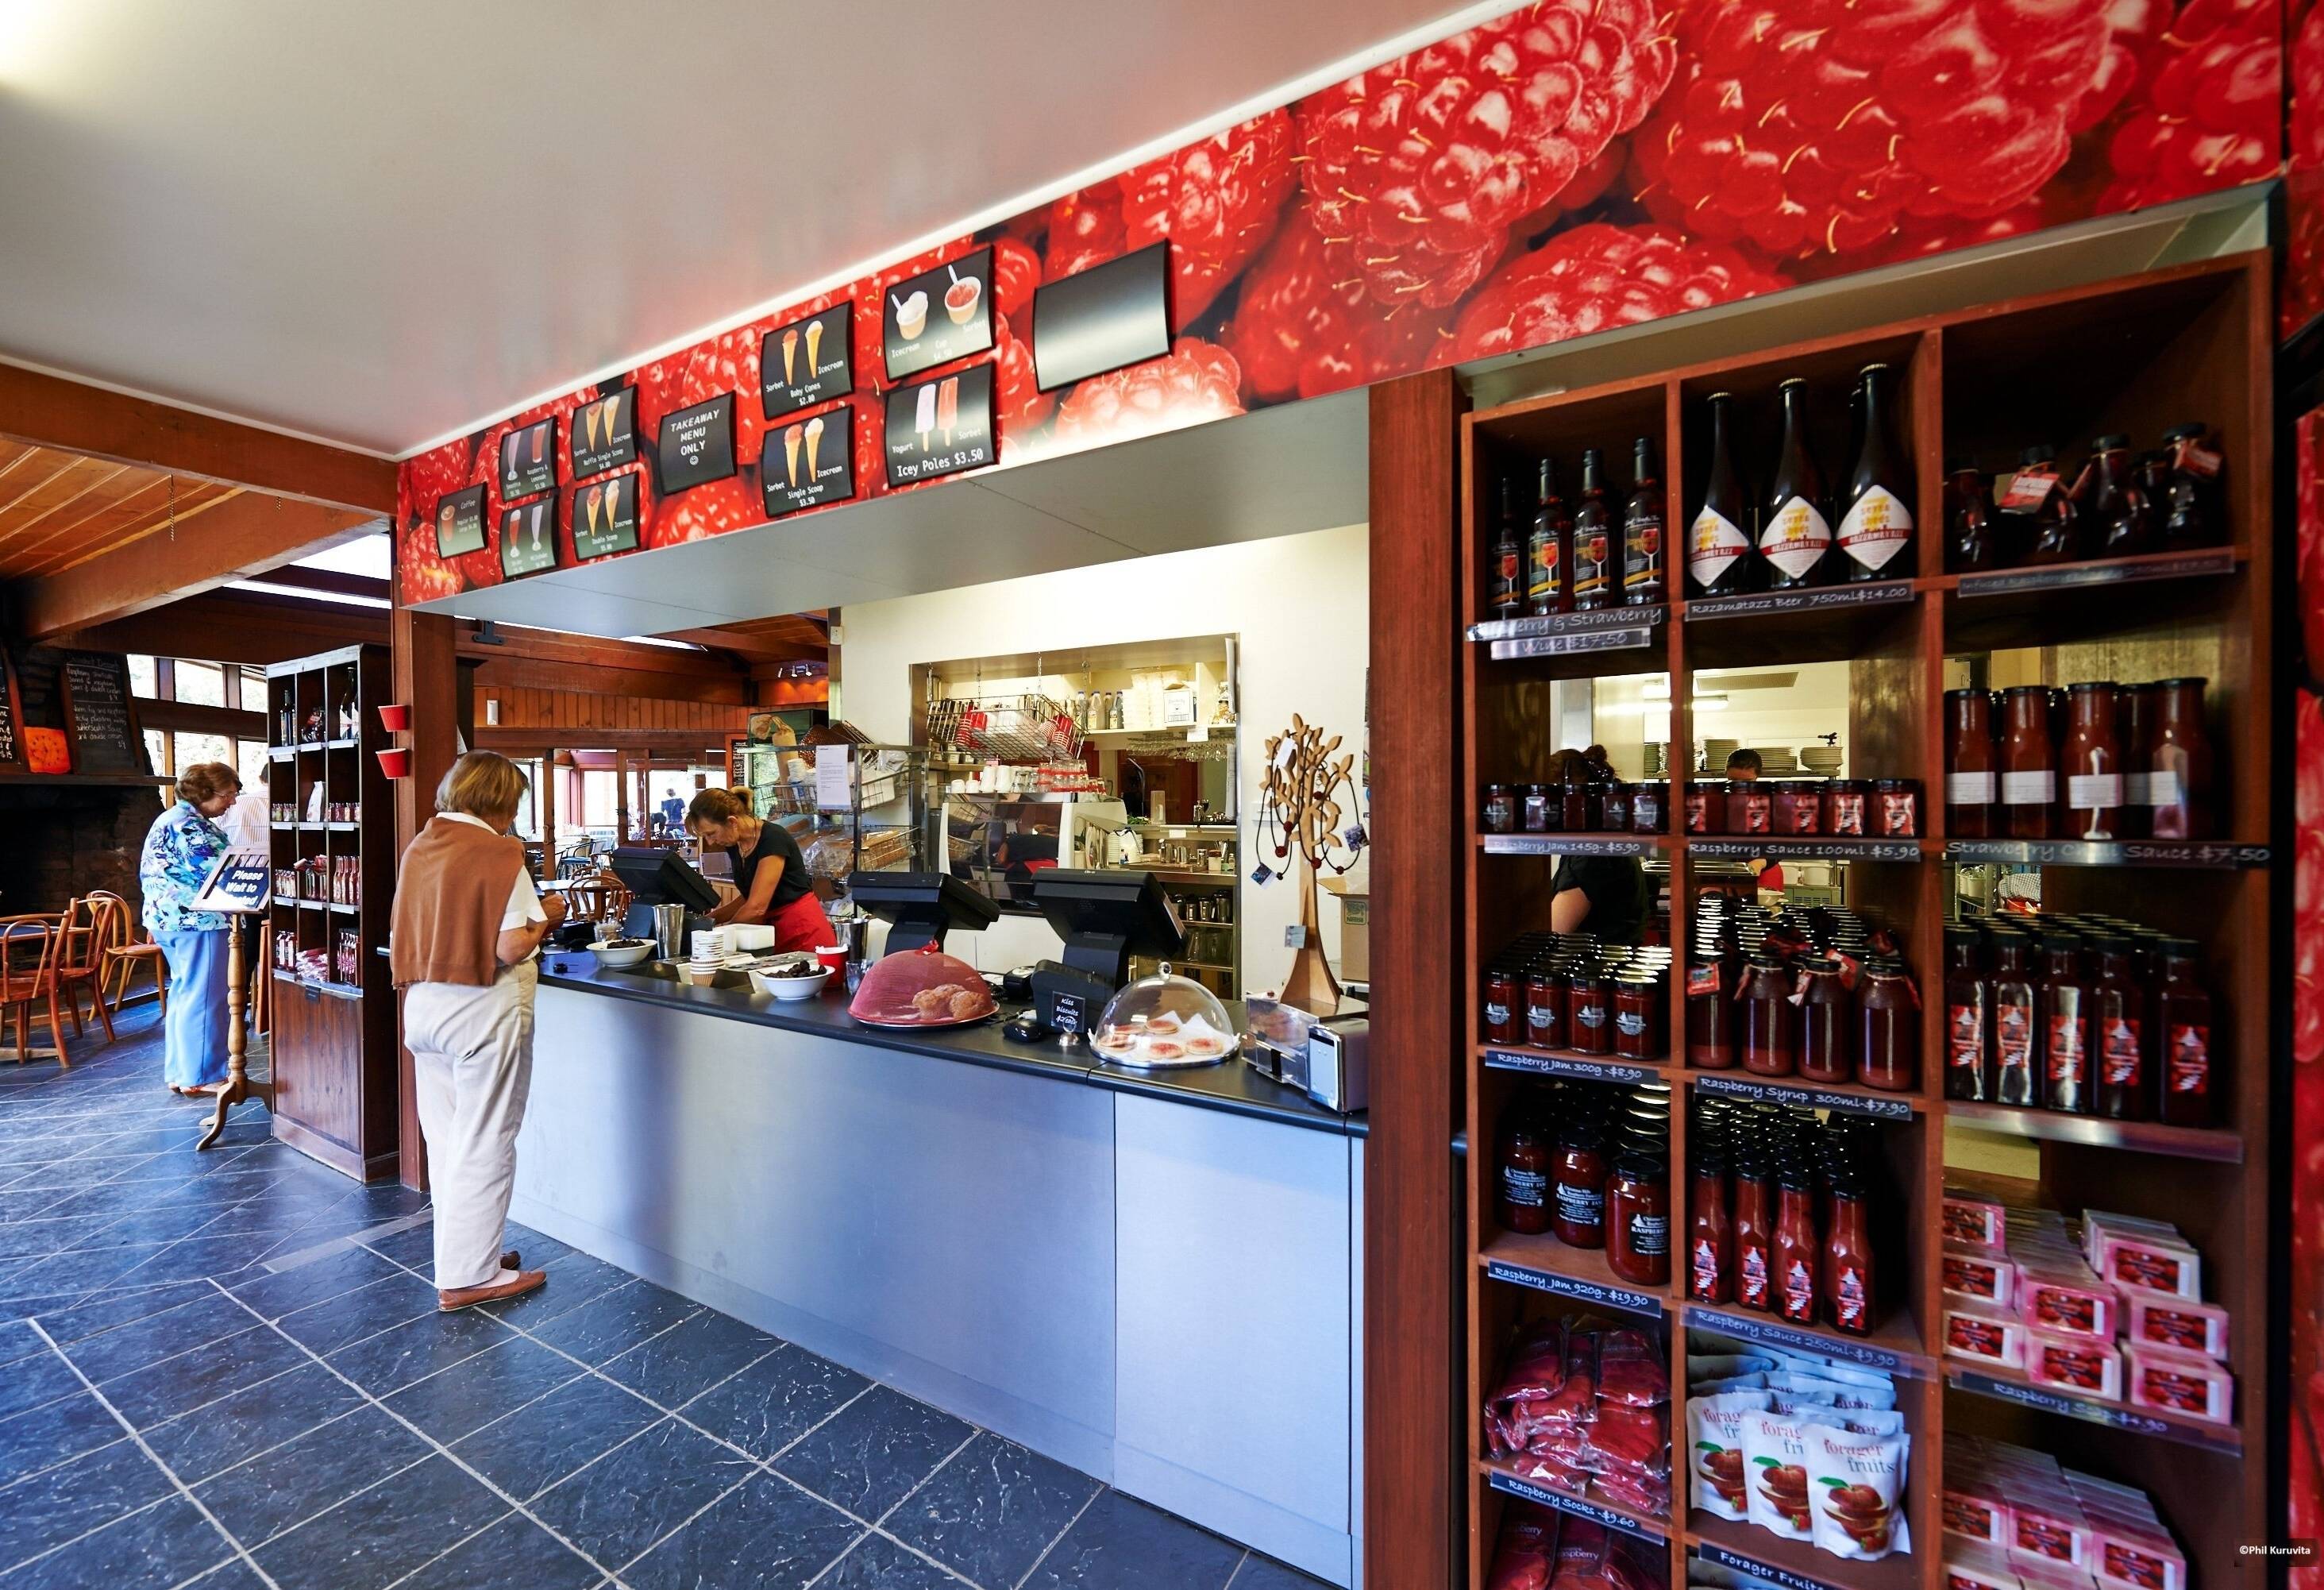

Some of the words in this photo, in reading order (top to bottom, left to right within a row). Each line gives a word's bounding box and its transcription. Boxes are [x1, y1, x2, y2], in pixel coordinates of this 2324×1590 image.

[891, 343, 920, 358] Icecream
[818, 360, 843, 375] Icecream
[766, 380, 784, 392] Sorbet
[790, 388, 803, 398] Baby
[805, 383, 821, 393] Cones
[671, 409, 719, 432] TAKEAWAY
[680, 426, 706, 442] MENU
[958, 429, 981, 440] Sorbet
[680, 440, 705, 456] ONLY
[892, 442, 913, 454] Yogurt
[897, 465, 919, 477] Icey
[923, 457, 950, 472] Poles
[954, 448, 984, 465] $3.50
[817, 465, 842, 478] Icecream
[767, 482, 785, 492] Sorbet
[788, 489, 806, 499] Single
[807, 484, 823, 495] Scoop
[461, 500, 476, 509] Coffee
[800, 496, 815, 507] $3.50
[1775, 597, 1801, 608] Beer
[1568, 608, 1662, 627] Strawberry
[1522, 639, 1563, 652] Wine
[1567, 632, 1627, 650] $17.50
[1605, 842, 1640, 855] $5.90
[1689, 843, 1760, 859] Raspberry
[1767, 844, 1811, 855] Sauce
[1817, 844, 1864, 855] 100ml
[1871, 846, 1920, 859] $5.90
[2124, 844, 2192, 860] Sauce
[2196, 845, 2271, 863] $7.50
[232, 870, 264, 880] Please
[225, 882, 245, 892] Wait
[246, 883, 257, 892] to
[1057, 1005, 1078, 1016] Biscuits
[1497, 1054, 1548, 1071] Raspberry
[1574, 1064, 1602, 1076] 300g
[1701, 1077, 1763, 1098] Raspberry
[1766, 1087, 1809, 1103] Syrup
[1494, 1267, 1546, 1287] Raspberry
[1609, 1290, 1648, 1306] $19.90
[1697, 1310, 1759, 1338] Raspberry
[1762, 1328, 1802, 1345] Sauce
[1994, 1383, 2069, 1414] Raspberry
[1824, 1438, 1883, 1457] forager
[1848, 1457, 1896, 1474] fruits
[1509, 1480, 1560, 1507] Raspberry
[1562, 1499, 1595, 1515] Socks
[1721, 1552, 1775, 1578] Forager
